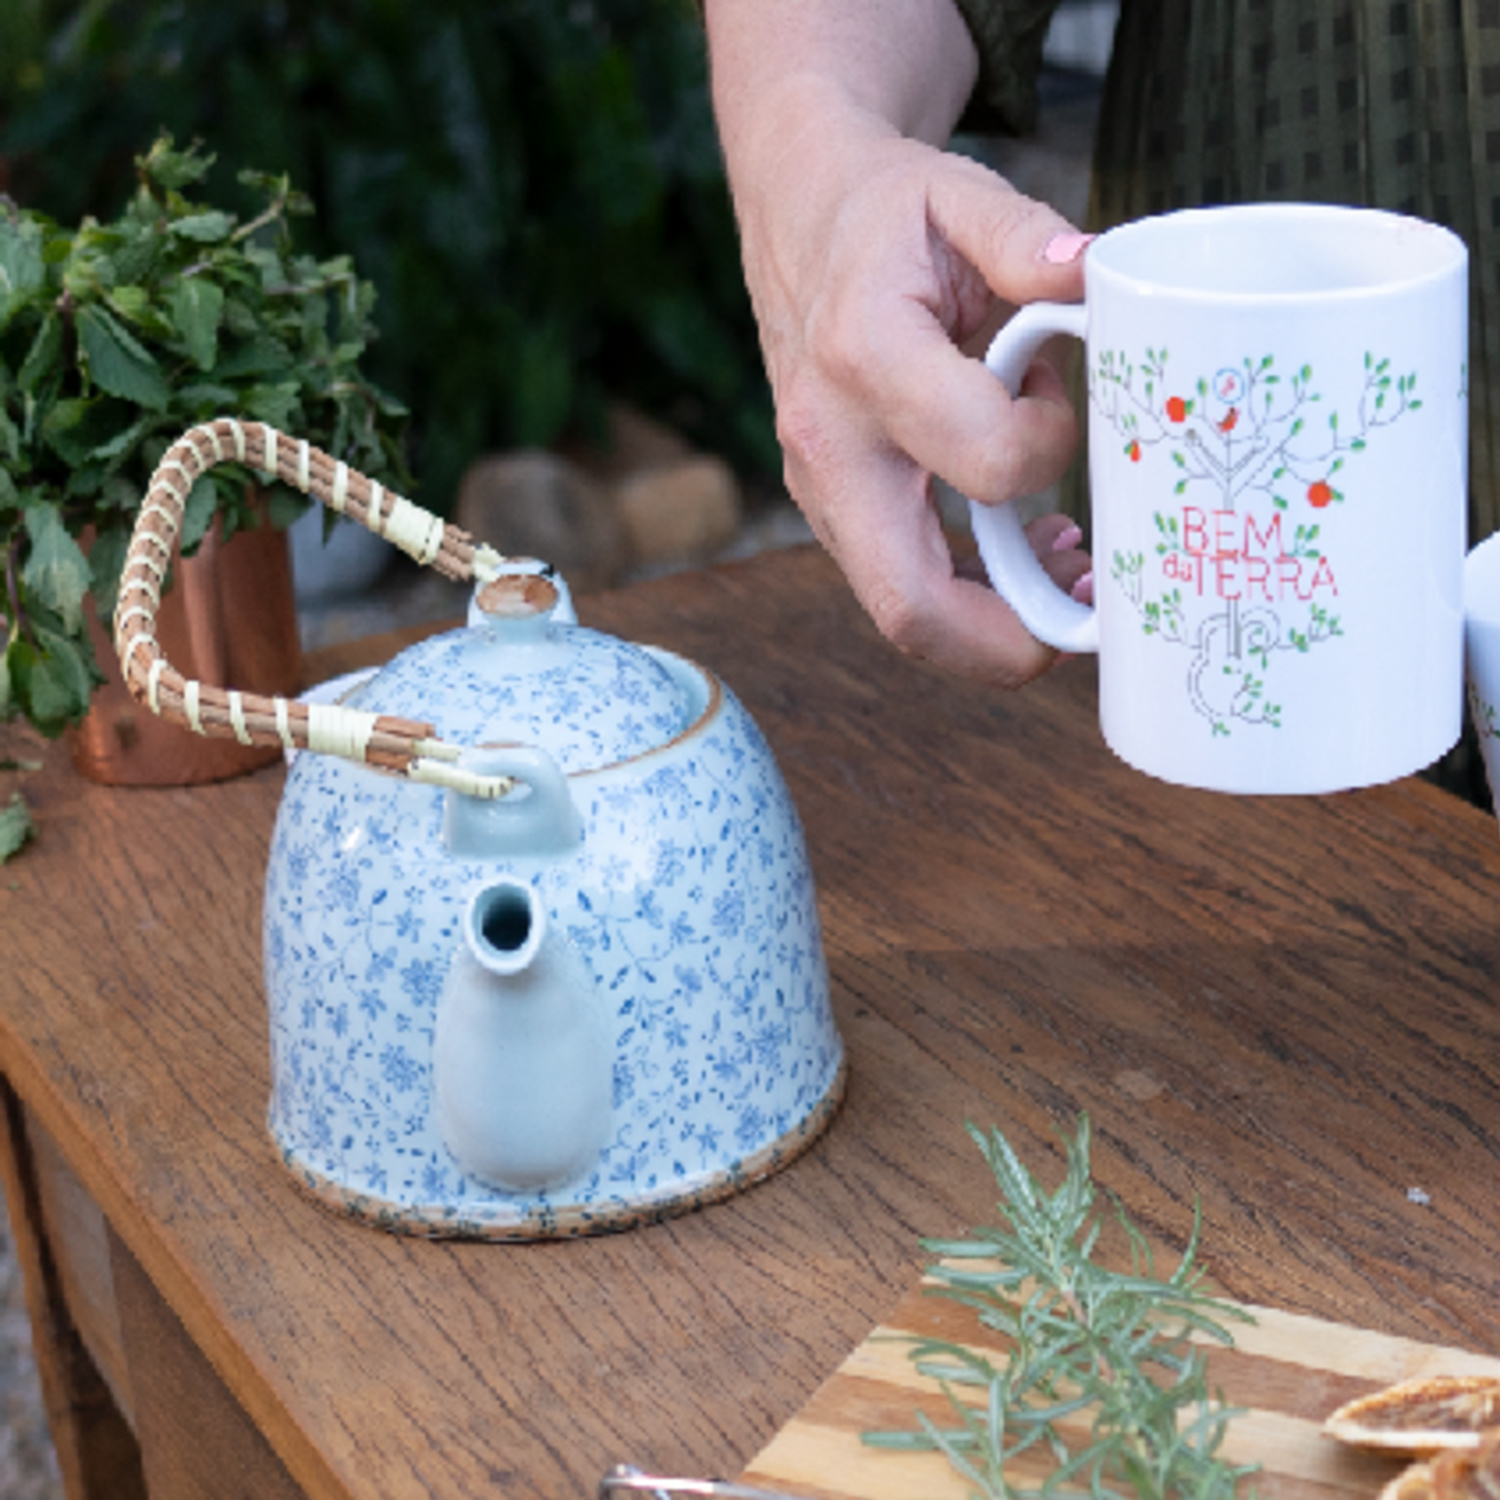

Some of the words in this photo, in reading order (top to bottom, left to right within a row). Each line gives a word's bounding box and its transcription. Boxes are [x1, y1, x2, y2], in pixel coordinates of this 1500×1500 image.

[1182, 506, 1287, 558] BEM
[1163, 553, 1192, 582] da
[1188, 553, 1338, 602] TERRA
